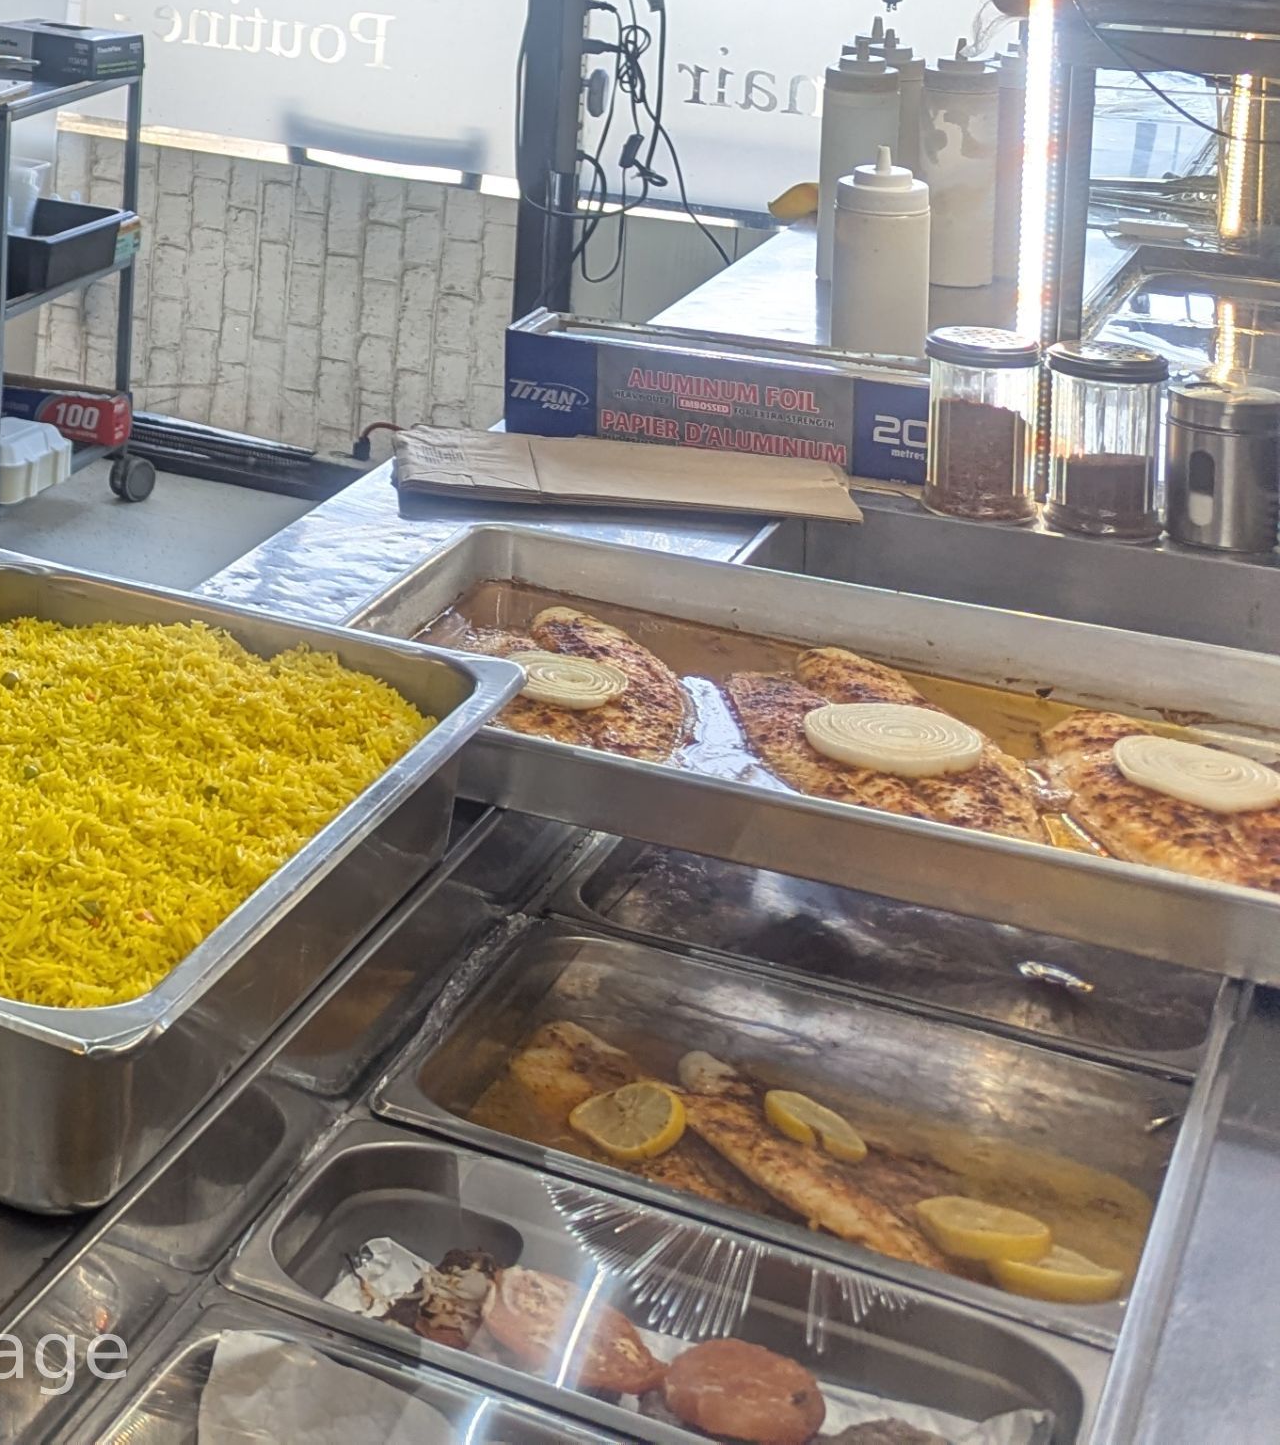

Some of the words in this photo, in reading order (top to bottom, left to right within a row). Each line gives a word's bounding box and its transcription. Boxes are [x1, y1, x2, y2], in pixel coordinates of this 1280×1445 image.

[508, 378, 577, 406] TITAN
[627, 367, 759, 405] ALUMINUM
[766, 385, 820, 414] FOIL
[56, 402, 100, 430] 100
[542, 402, 573, 413] FOIL
[678, 397, 730, 415] EMBOSSED
[786, 413, 836, 429] STRENGTH
[872, 414, 929, 449] 20
[601, 408, 680, 441] PAPIER
[684, 420, 848, 466] D'ALUMINIUM
[890, 449, 925, 461] metres
